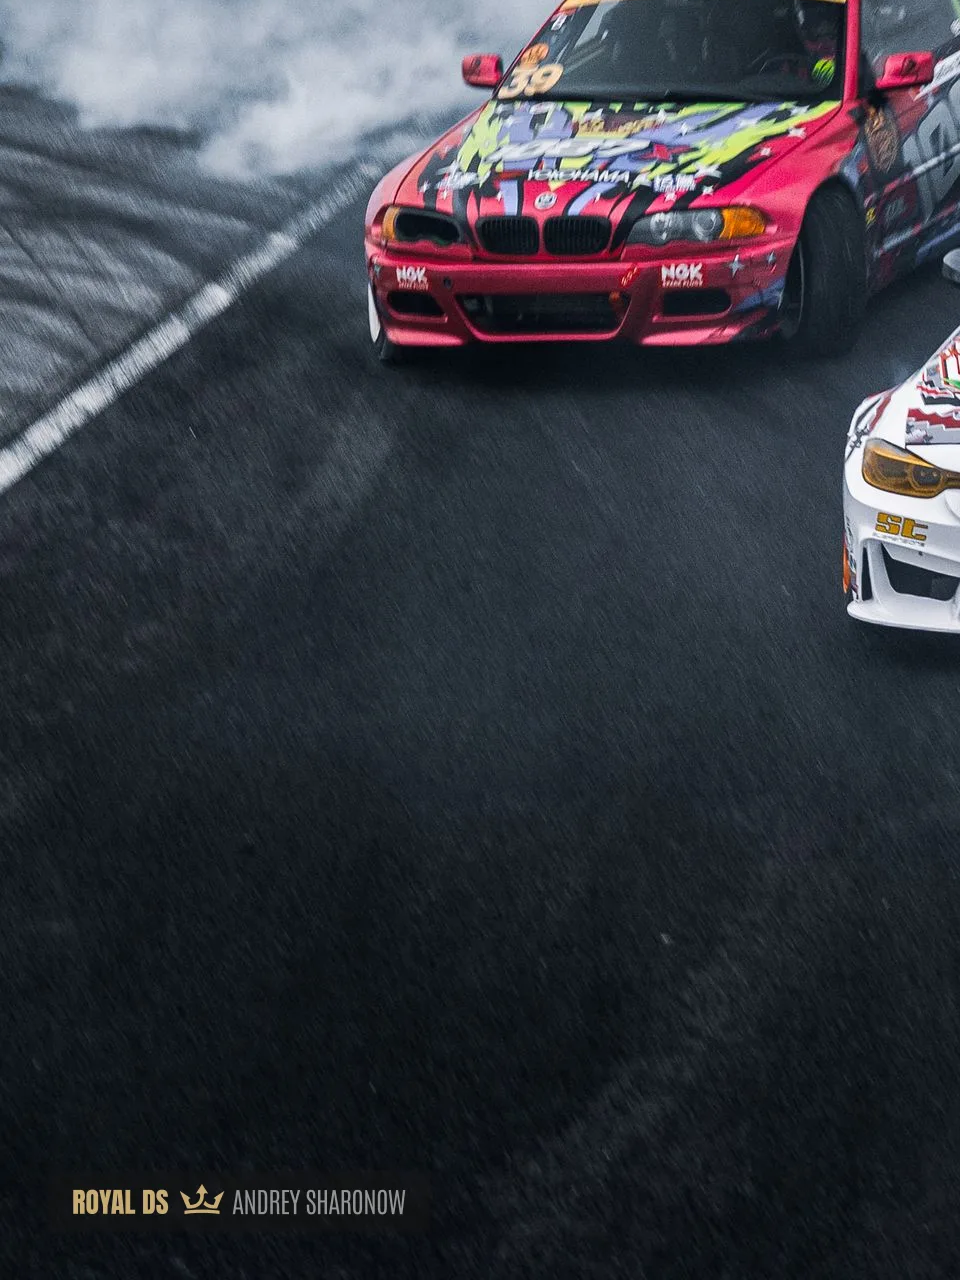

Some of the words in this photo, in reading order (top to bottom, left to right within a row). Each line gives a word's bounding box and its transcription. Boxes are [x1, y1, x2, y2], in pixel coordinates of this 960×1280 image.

[497, 63, 564, 99] 39
[528, 168, 630, 183] YOKOHAMA
[396, 265, 428, 284] NGK
[661, 263, 703, 281] NGK
